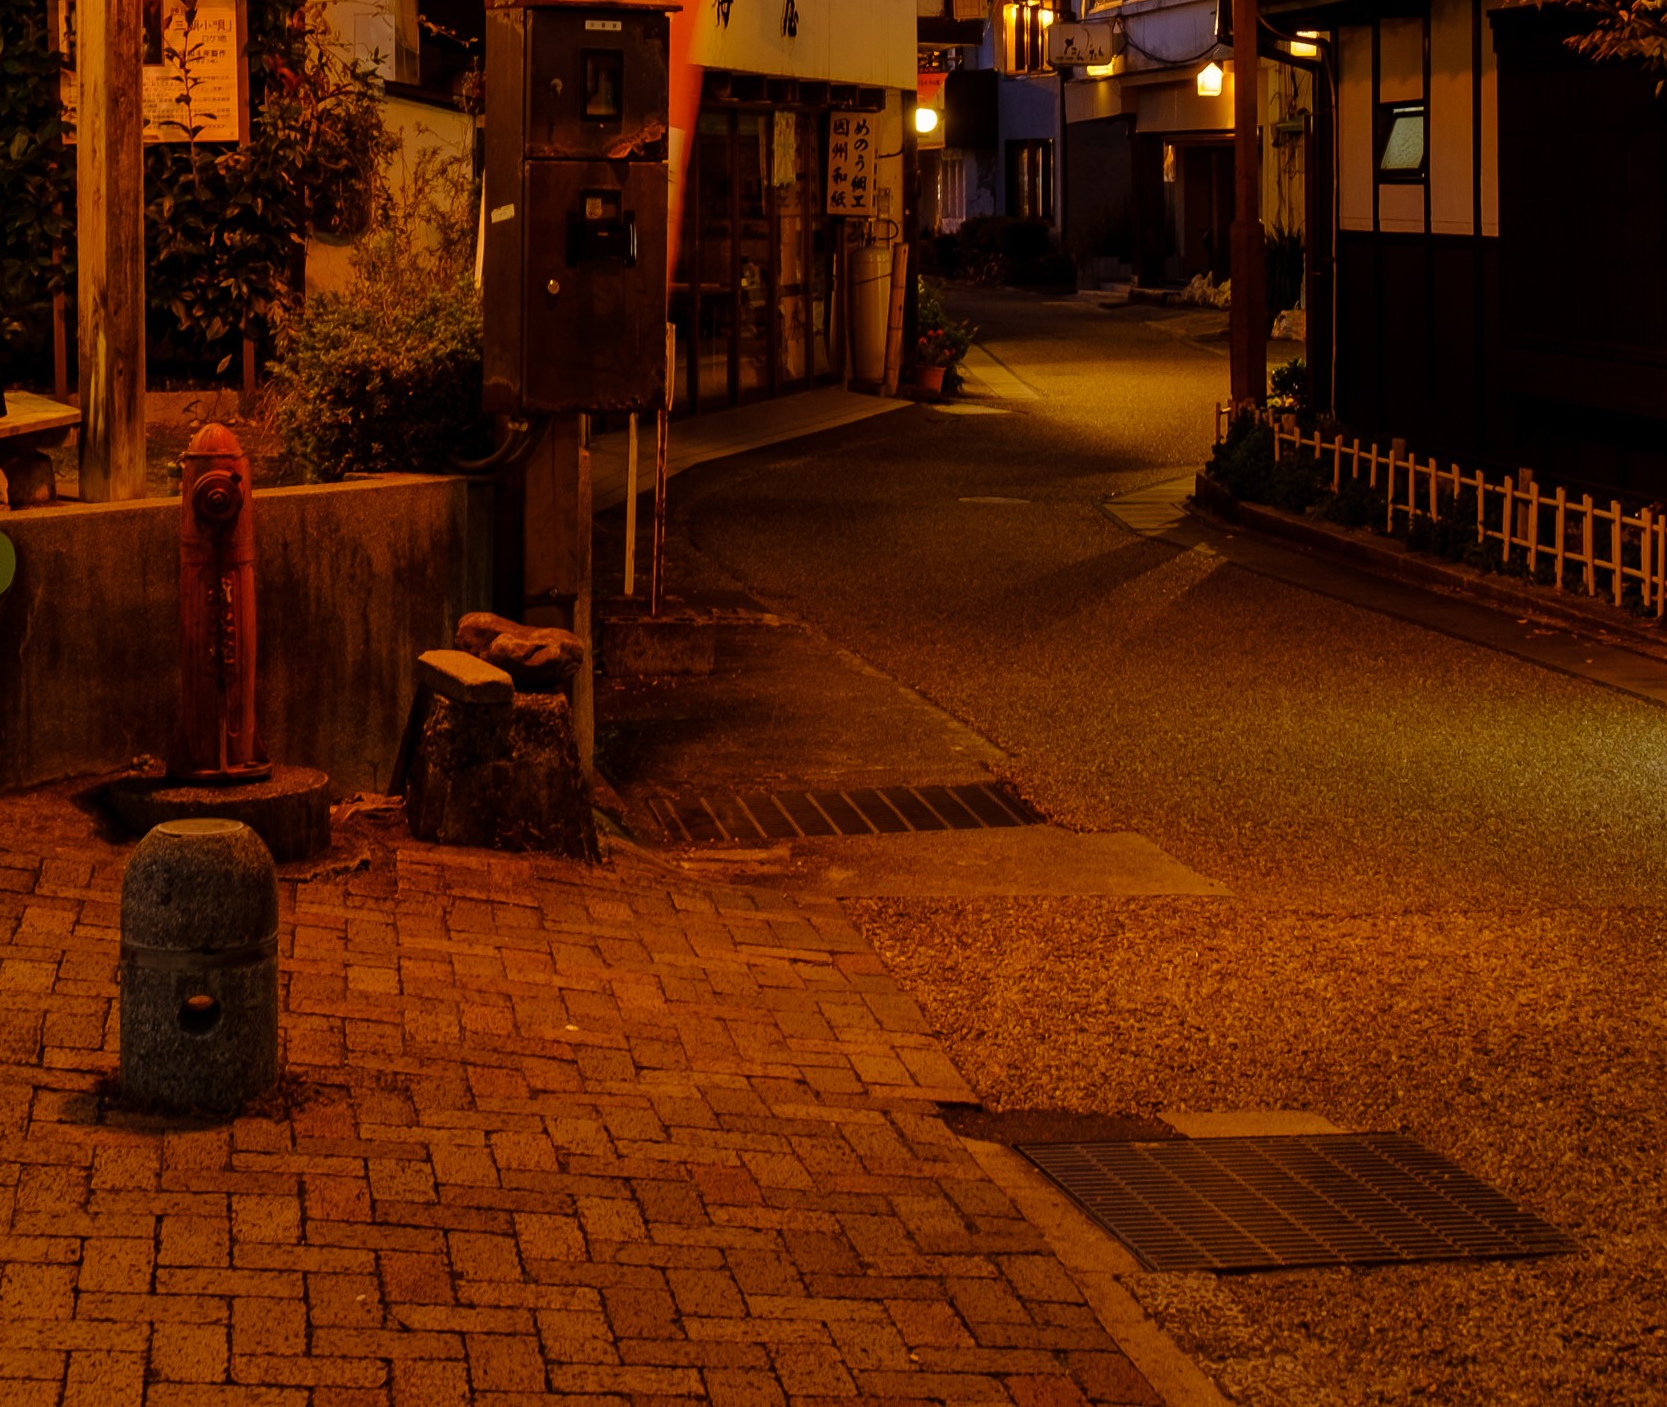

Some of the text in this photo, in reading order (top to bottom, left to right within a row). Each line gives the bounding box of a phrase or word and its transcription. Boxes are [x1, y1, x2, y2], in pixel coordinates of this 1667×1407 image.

[850, 118, 870, 208] めのう細工
